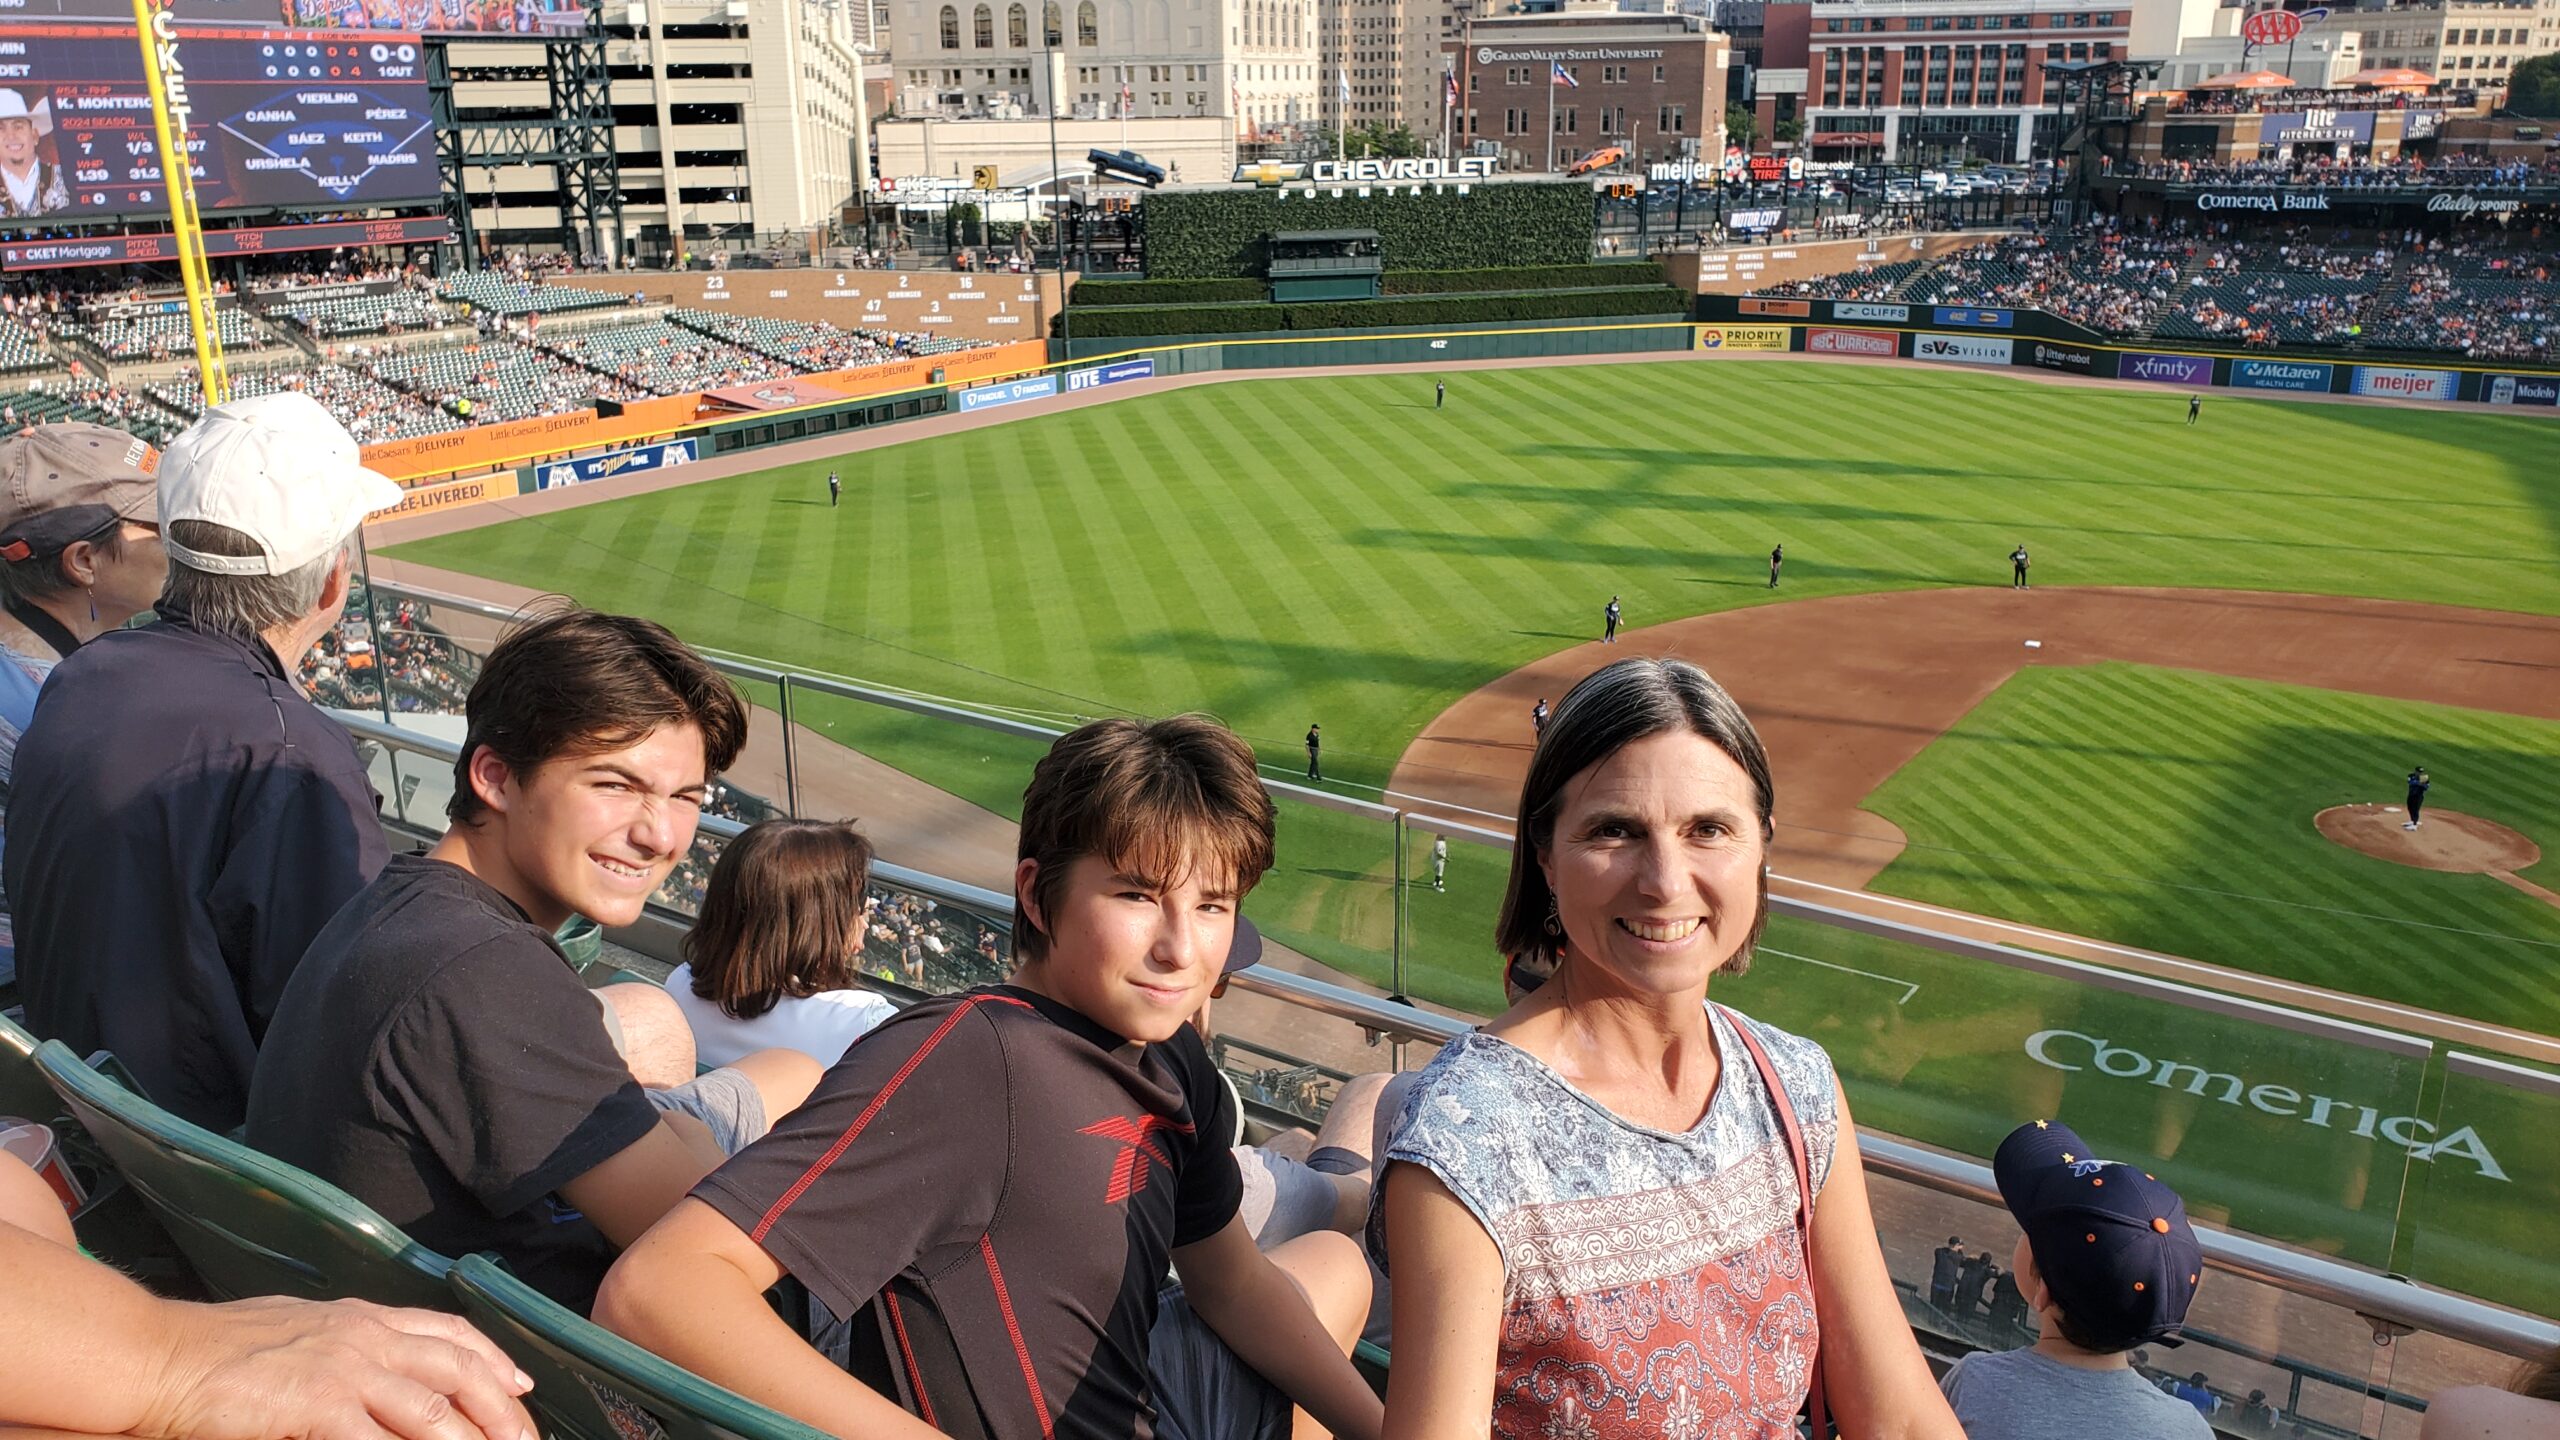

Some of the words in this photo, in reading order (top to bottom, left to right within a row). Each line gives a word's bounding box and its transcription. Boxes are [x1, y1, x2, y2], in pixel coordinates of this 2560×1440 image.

[2249, 13, 2296, 44] AAA
[0, 42, 25, 55] MIN
[262, 45, 274, 57] 0
[285, 45, 296, 57] 0
[306, 45, 317, 57] 0
[327, 46, 338, 57] 0
[347, 46, 358, 57] 4
[370, 44, 416, 62] 0-0
[266, 65, 277, 77] 0
[288, 65, 299, 77] 0
[309, 65, 320, 77] 0
[330, 66, 341, 77] 0
[350, 66, 361, 77] 4
[56, 97, 73, 109] K.
[296, 92, 358, 104] VIERLING
[245, 110, 296, 122] CANHA
[365, 107, 407, 119] PÉREZ
[2304, 108, 2336, 130] Lite
[63, 117, 90, 127] 2024
[91, 117, 135, 126] SEASON
[288, 132, 325, 145] BÁEZ
[343, 131, 383, 143] KEITH
[2279, 129, 2330, 139] PITCHER'S
[2336, 128, 2354, 138] PUB
[81, 143, 92, 154] 7
[126, 142, 153, 155] 1/3
[245, 157, 311, 170] URSHELA
[368, 153, 418, 165] MADRIS
[1750, 158, 1787, 168] BELLE
[76, 169, 109, 181] 1.39
[129, 167, 161, 181] 31.2
[1312, 156, 1497, 181] CHEVROLET
[1651, 157, 1713, 184] meijer
[1754, 168, 1781, 180] TIRE
[318, 175, 361, 187] KELLY
[869, 175, 940, 192] ROCKET
[93, 193, 106, 205] 0
[139, 190, 152, 202] 3
[1279, 184, 1470, 200] FOUNTAIN
[2282, 193, 2330, 210] Bank
[2427, 193, 2479, 220] Bally
[2480, 199, 2520, 211] SPORTS
[1730, 211, 1761, 228] MOTOR
[1760, 209, 1782, 226] CITY
[235, 232, 263, 241] PITCH
[126, 240, 158, 249] PITCH
[239, 240, 263, 249] TYPE
[1868, 241, 1877, 252] 11
[1910, 238, 1923, 250] 42
[7, 247, 57, 262] ROCKET
[60, 245, 111, 258] Mortgage
[126, 248, 160, 257] SPEED
[706, 276, 724, 289] 23
[836, 274, 845, 286] 5
[899, 276, 908, 288] 2
[960, 277, 973, 289] 16
[1024, 279, 1033, 291] 6
[285, 289, 324, 301] Together
[866, 299, 881, 312] 47
[930, 301, 940, 313] 3
[999, 301, 1006, 313] 1
[1861, 307, 1906, 318] CLIFFS
[1727, 331, 1782, 340] PRIORITY
[1962, 346, 2006, 358] VISION
[2134, 357, 2197, 380] xfinity
[2263, 364, 2321, 380] McLaren
[1070, 370, 1100, 390] DTE
[2256, 379, 2284, 388] HEALTH
[2285, 381, 2305, 389] CARE
[2373, 373, 2436, 394] meijer
[2517, 384, 2556, 398] Modelo
[490, 428, 511, 441] Little
[545, 415, 590, 433] DELIVERY
[415, 436, 465, 456] DELIVERY
[630, 454, 649, 466] TIME
